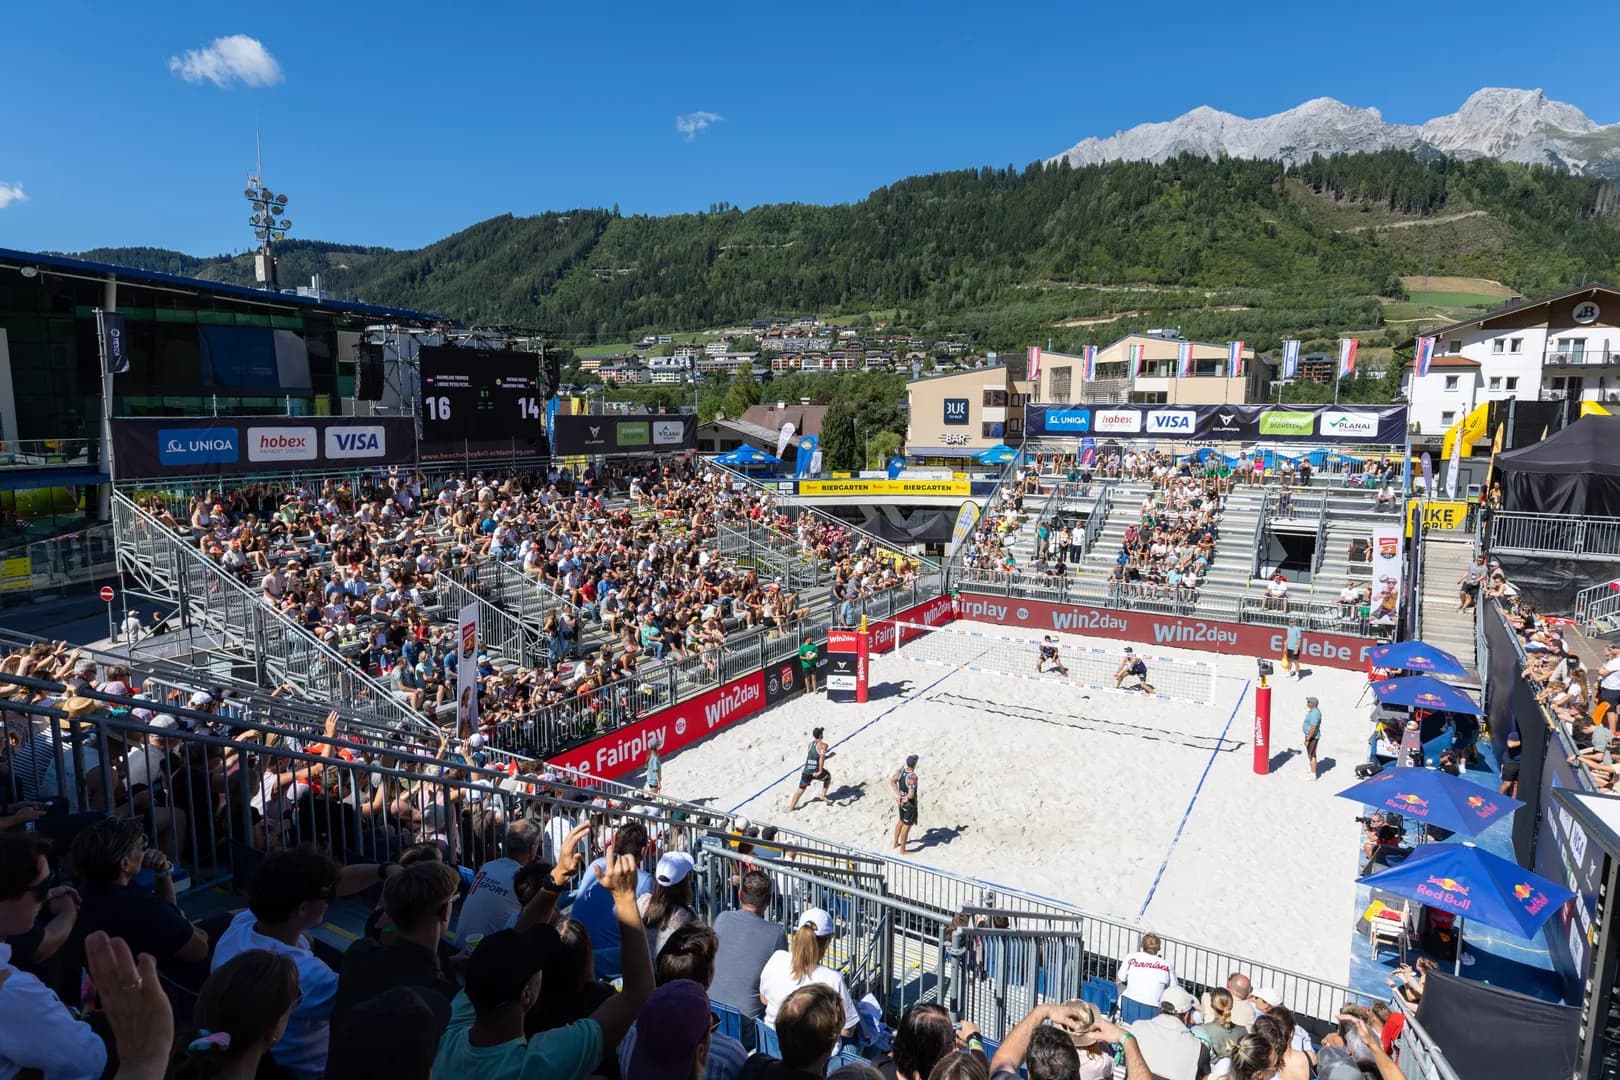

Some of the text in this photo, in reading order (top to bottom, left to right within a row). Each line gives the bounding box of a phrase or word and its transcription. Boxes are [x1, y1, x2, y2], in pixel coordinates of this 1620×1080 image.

[425, 396, 451, 420] 16
[518, 398, 539, 419] 14
[1102, 415, 1132, 424] hobex
[1155, 415, 1189, 428] VISA
[1339, 422, 1370, 430] PLANAI
[189, 440, 233, 452] UNIQA
[260, 435, 306, 448] hobex
[332, 433, 379, 450] VISA
[1052, 609, 1128, 632] win2day
[829, 634, 856, 643] win2day
[1153, 621, 1237, 644] win2day
[1270, 634, 1352, 660] Elebe
[704, 683, 760, 729] win2day
[596, 725, 667, 772] Fairplay
[1385, 799, 1429, 816] Red Bull
[479, 882, 509, 896] SPORT
[1416, 883, 1472, 911] Red Bull
